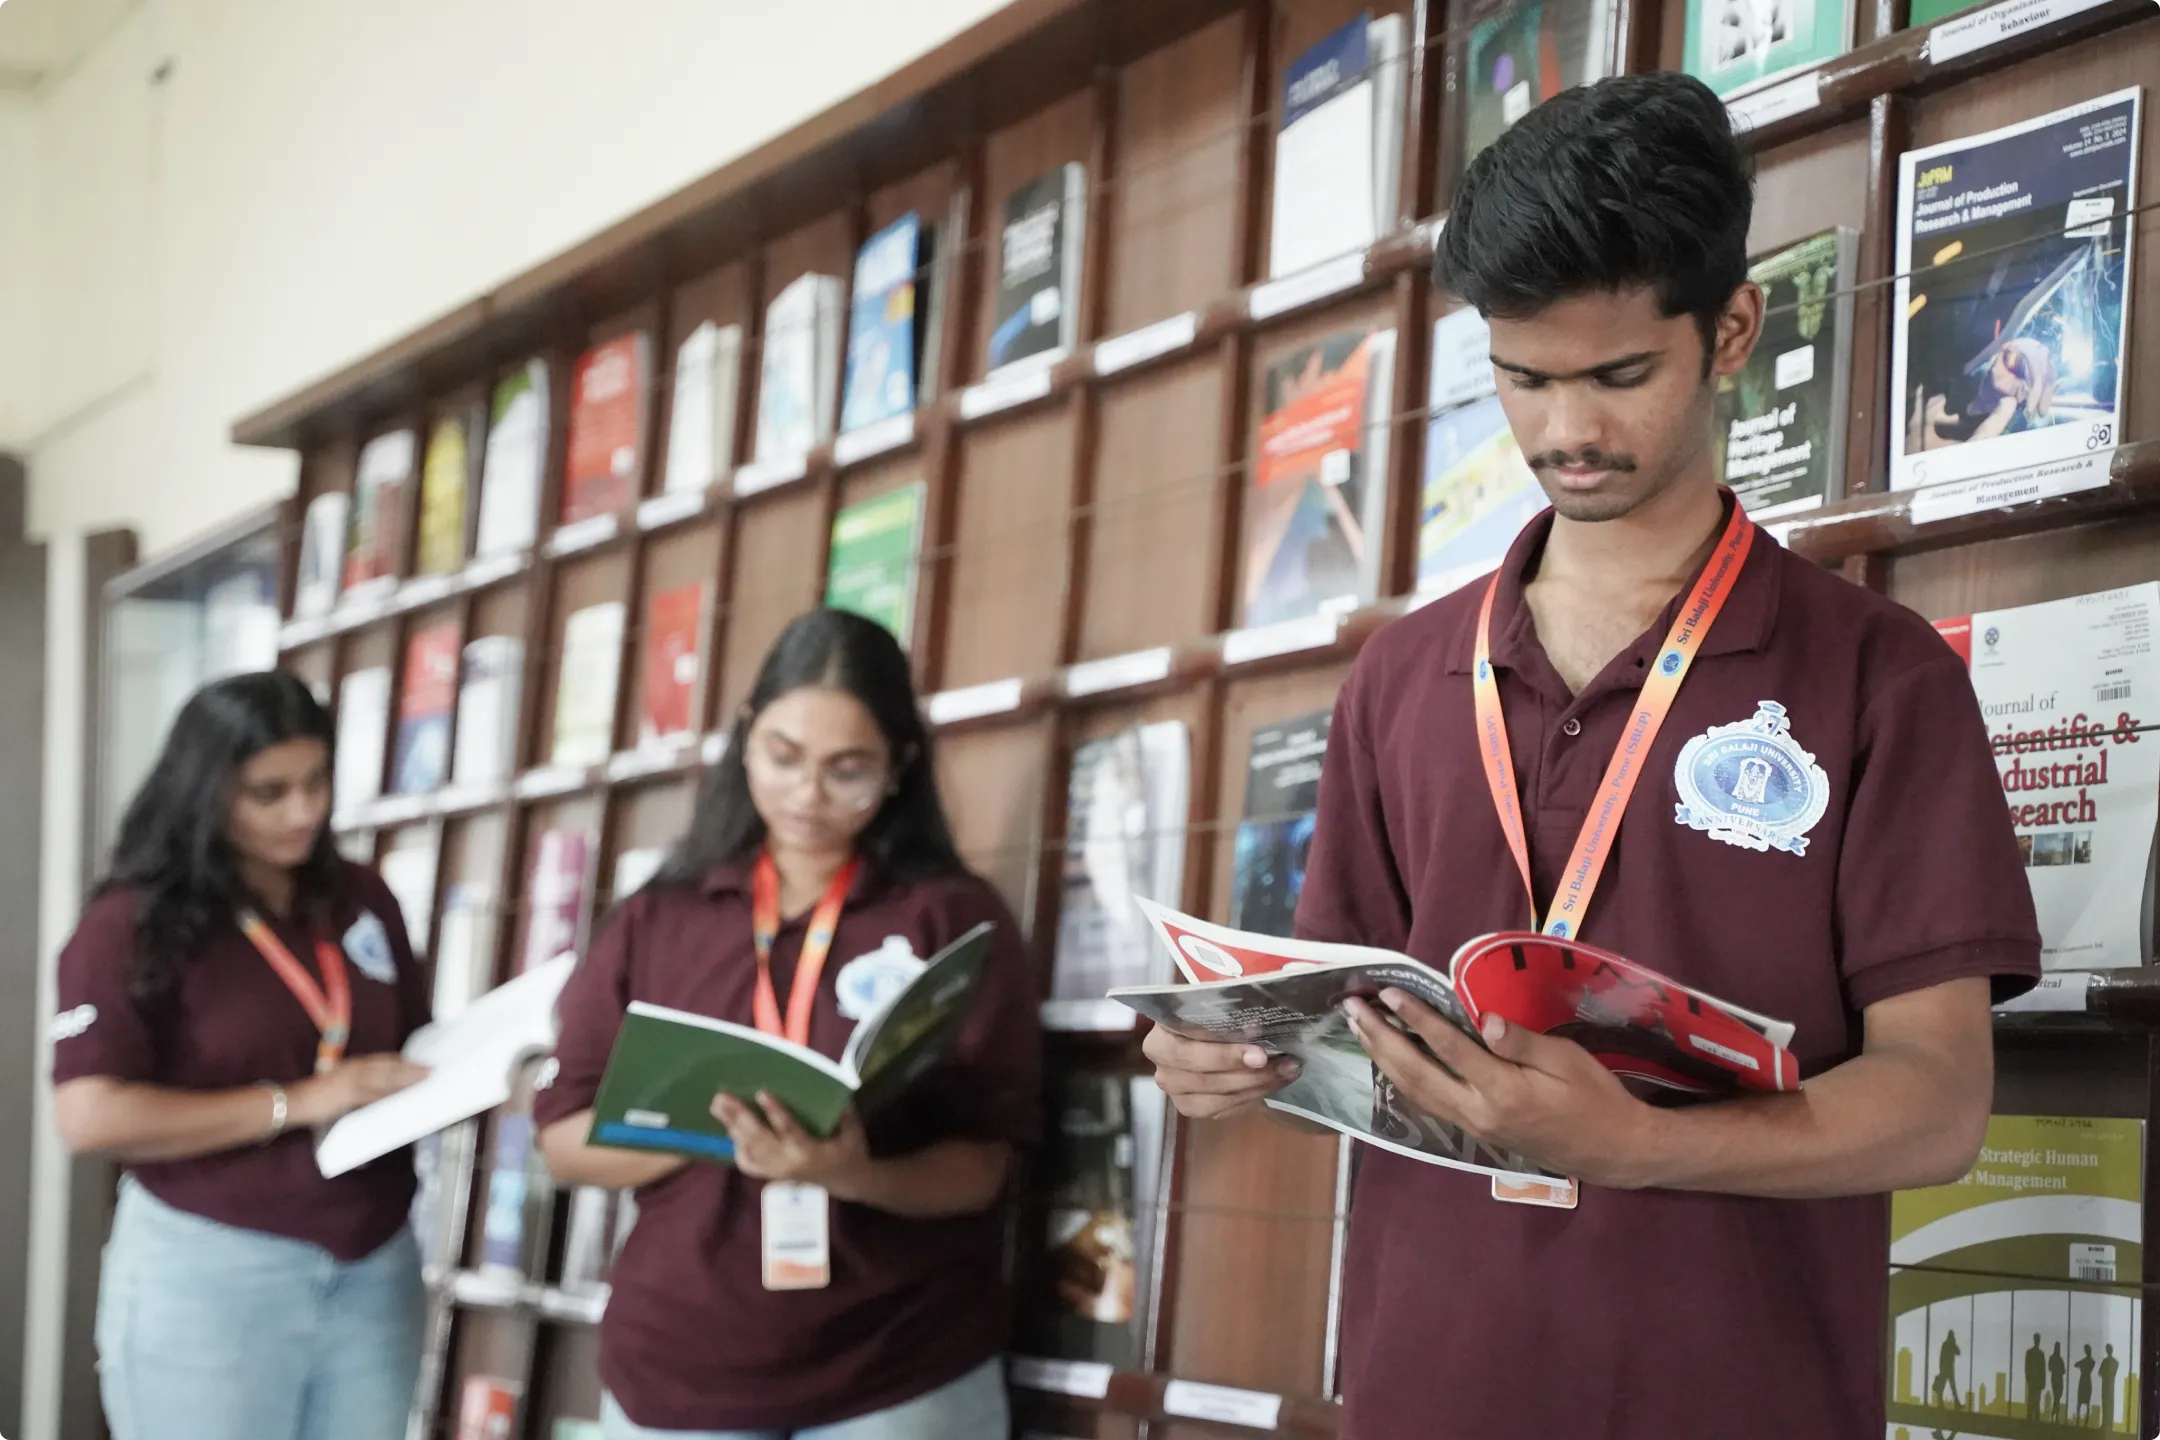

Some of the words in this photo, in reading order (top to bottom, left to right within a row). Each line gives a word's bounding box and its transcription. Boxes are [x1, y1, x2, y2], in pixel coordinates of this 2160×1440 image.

[1940, 19, 1976, 39] Journal
[1978, 15, 1988, 27] of
[2000, 8, 2051, 33] Behaviour
[1914, 211, 1960, 235] Research
[1962, 208, 1970, 223] &
[1971, 192, 2033, 219] Management
[1915, 195, 1953, 218] Journal
[1954, 191, 1966, 209] of
[1966, 181, 2019, 205] Production
[1728, 406, 1780, 440] Journal
[1779, 402, 1797, 427] of
[1726, 439, 1812, 480] Management
[1930, 486, 1966, 500] Journal
[1968, 482, 1978, 493] of
[1981, 472, 2034, 489] Production
[2036, 462, 2083, 479] Research
[2085, 459, 2094, 468] &
[1976, 484, 2040, 505] Management
[1676, 628, 1693, 646] Sri
[1685, 596, 1711, 629] Balaji
[1702, 553, 1737, 599] University,
[1979, 693, 2034, 717] Journal
[2039, 690, 2059, 711] of
[1624, 711, 1652, 756] (SBUP)
[1985, 712, 2105, 756] cientific
[2112, 712, 2141, 745] &
[1611, 757, 1632, 789] Pune
[1703, 749, 1719, 767] SRI
[1720, 742, 1759, 755] BALAJI
[1760, 744, 1803, 794] UNIVERSITY
[2001, 748, 2108, 793] dustrial
[1584, 791, 1620, 855] University,
[1730, 801, 1761, 817] PUNE
[2009, 788, 2097, 827] search
[1697, 815, 1784, 844] ANNIVERSARY
[1569, 856, 1593, 894] Balaji
[1562, 893, 1577, 913] Sri
[1366, 968, 1446, 997] aramco
[1979, 1146, 2043, 1168] Strategic
[2045, 1150, 2099, 1167] Human
[1975, 1169, 2068, 1192] Management
